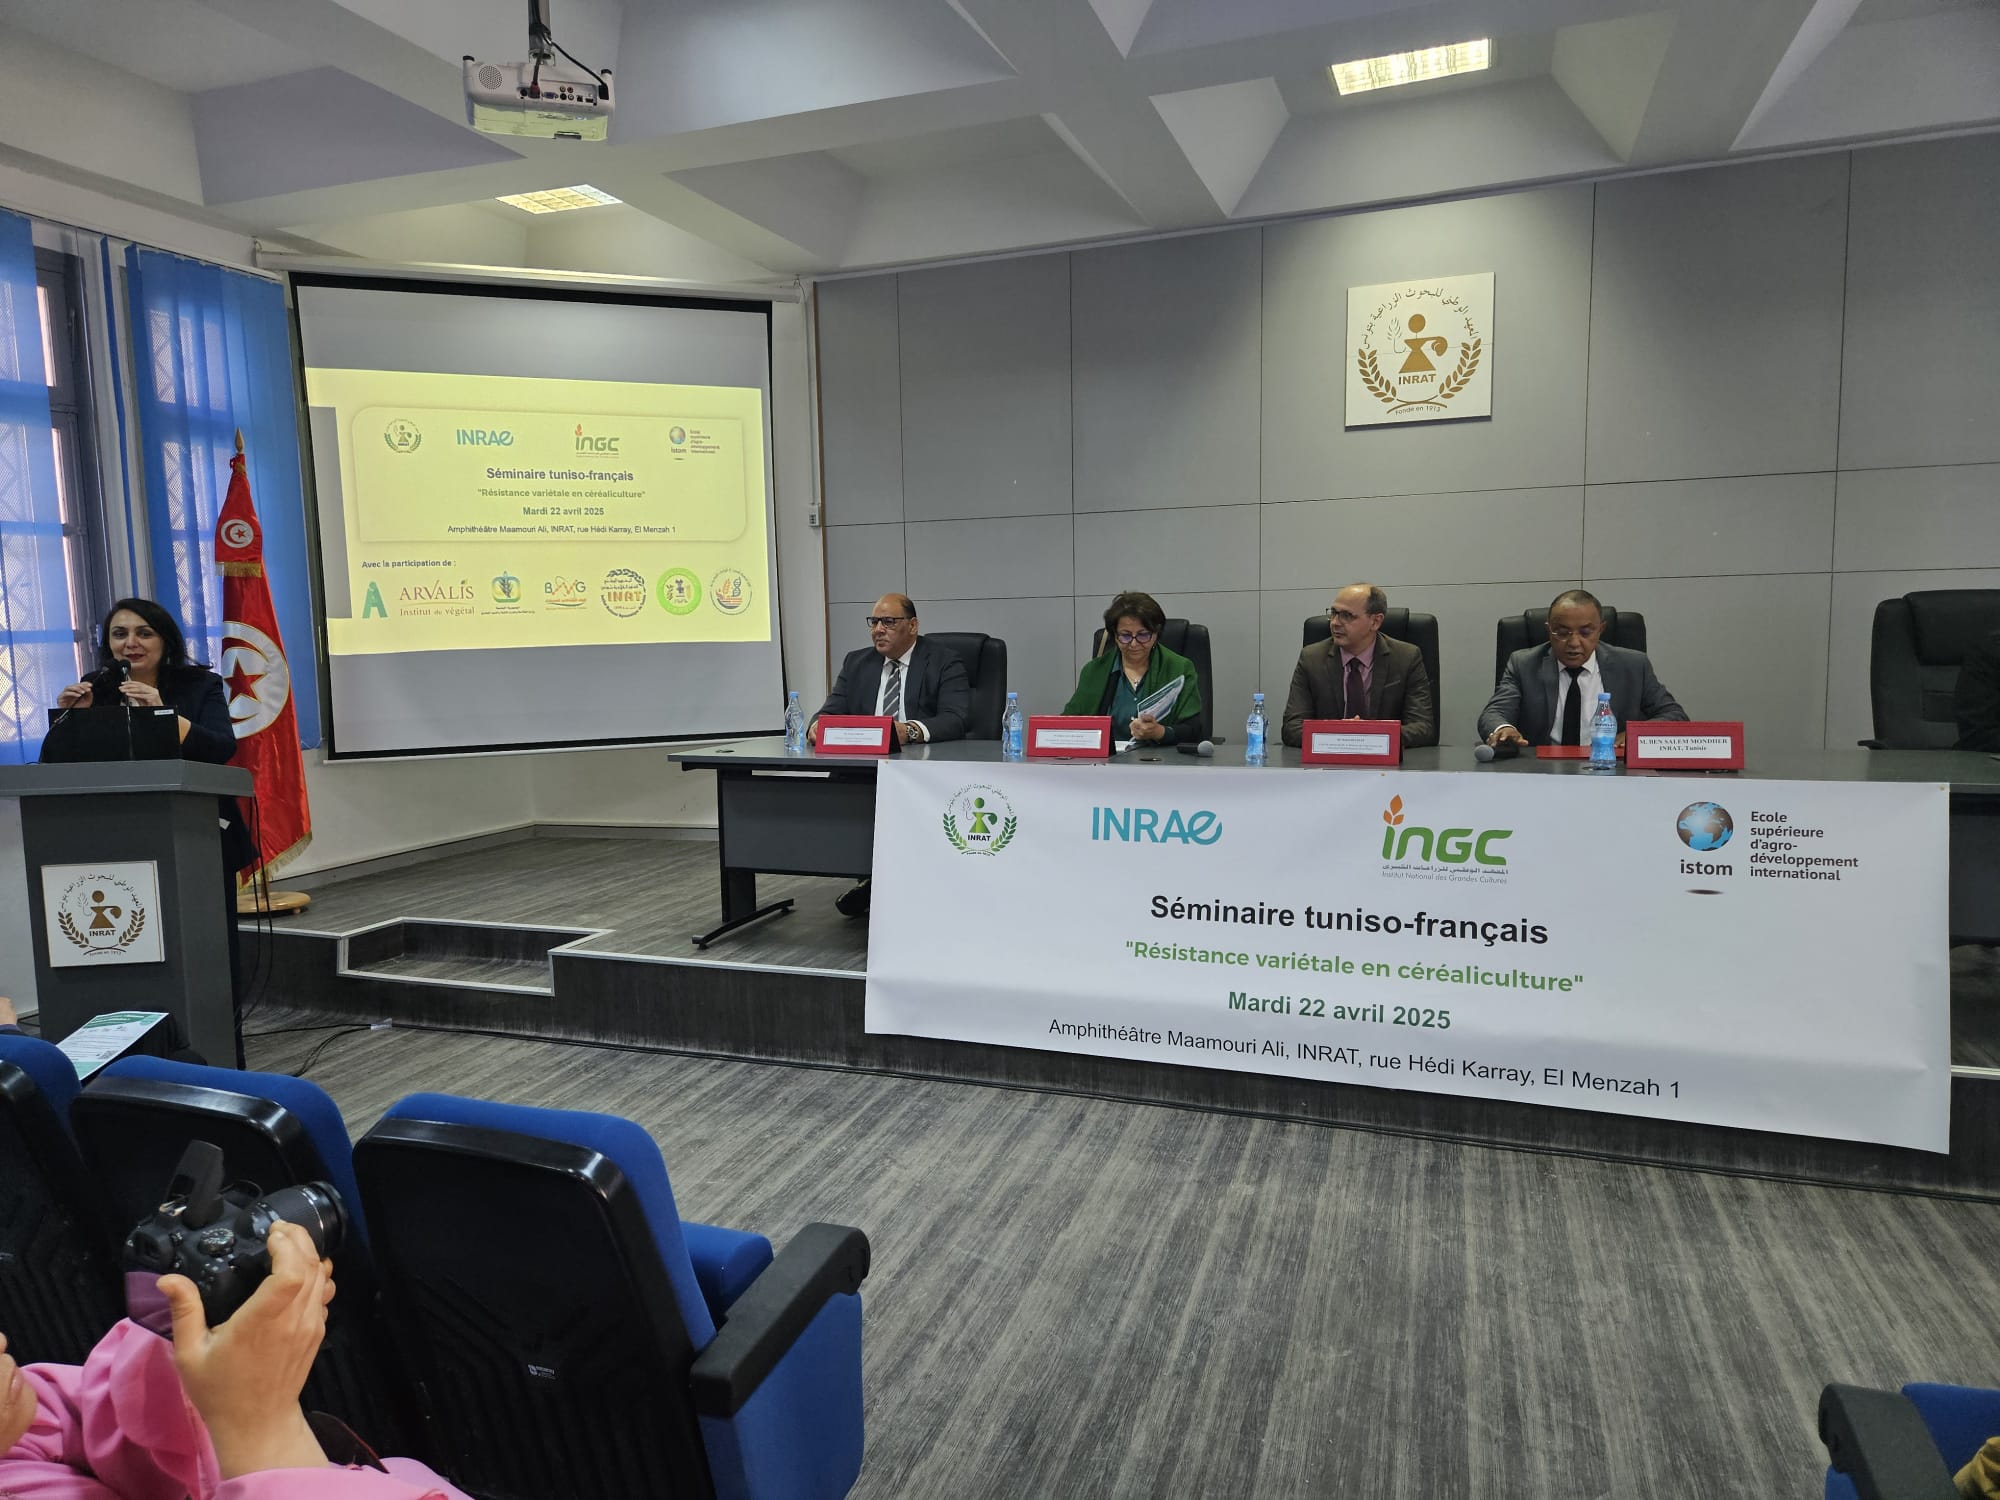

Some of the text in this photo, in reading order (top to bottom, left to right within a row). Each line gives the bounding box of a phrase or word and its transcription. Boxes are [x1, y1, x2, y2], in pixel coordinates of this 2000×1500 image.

[1398, 373, 1436, 385] INRAT
[486, 467, 634, 483] Séminaire tuniso-français
[478, 488, 530, 498] "Résistance
[531, 488, 570, 498] variétale
[523, 506, 605, 517] Mardi 22 avril 2025
[447, 525, 498, 535] Amphithéâtre
[499, 525, 536, 534] Maamouri
[537, 525, 549, 535] Ali,
[550, 525, 576, 535] INRAT,
[590, 525, 607, 534] Hédi
[608, 525, 633, 536] Karray,
[634, 525, 642, 534] El
[643, 525, 670, 534] Menzah
[672, 525, 676, 534] 1
[362, 561, 381, 569] Avec
[382, 560, 390, 568] la
[391, 559, 441, 569] participation
[442, 559, 452, 567] de
[400, 580, 475, 601] ARVALIS
[400, 607, 432, 617] Institut
[445, 606, 475, 617] végétal
[1751, 811, 1787, 823] Ecole
[967, 834, 991, 842] INRAT
[1750, 825, 1824, 838] supérieure
[1750, 853, 1859, 868] développement
[1680, 859, 1733, 876] istom
[1750, 866, 1841, 881] international
[1382, 871, 1404, 879] Institut
[1405, 872, 1434, 881] National
[1448, 875, 1478, 883] Grandes
[1479, 876, 1508, 884] Cultures
[1151, 895, 1549, 947] Séminaire tuniso-français
[89, 929, 116, 937] INRAT
[1126, 940, 1584, 992] "Résistance variétale en céréaliculture"
[1228, 991, 1451, 1029] Mardi 22 avril 2025
[1048, 1018, 1679, 1099] Amphithéâtre Maamouri Ali, INRAT, rue Hédi Karray, El Menzah 1
